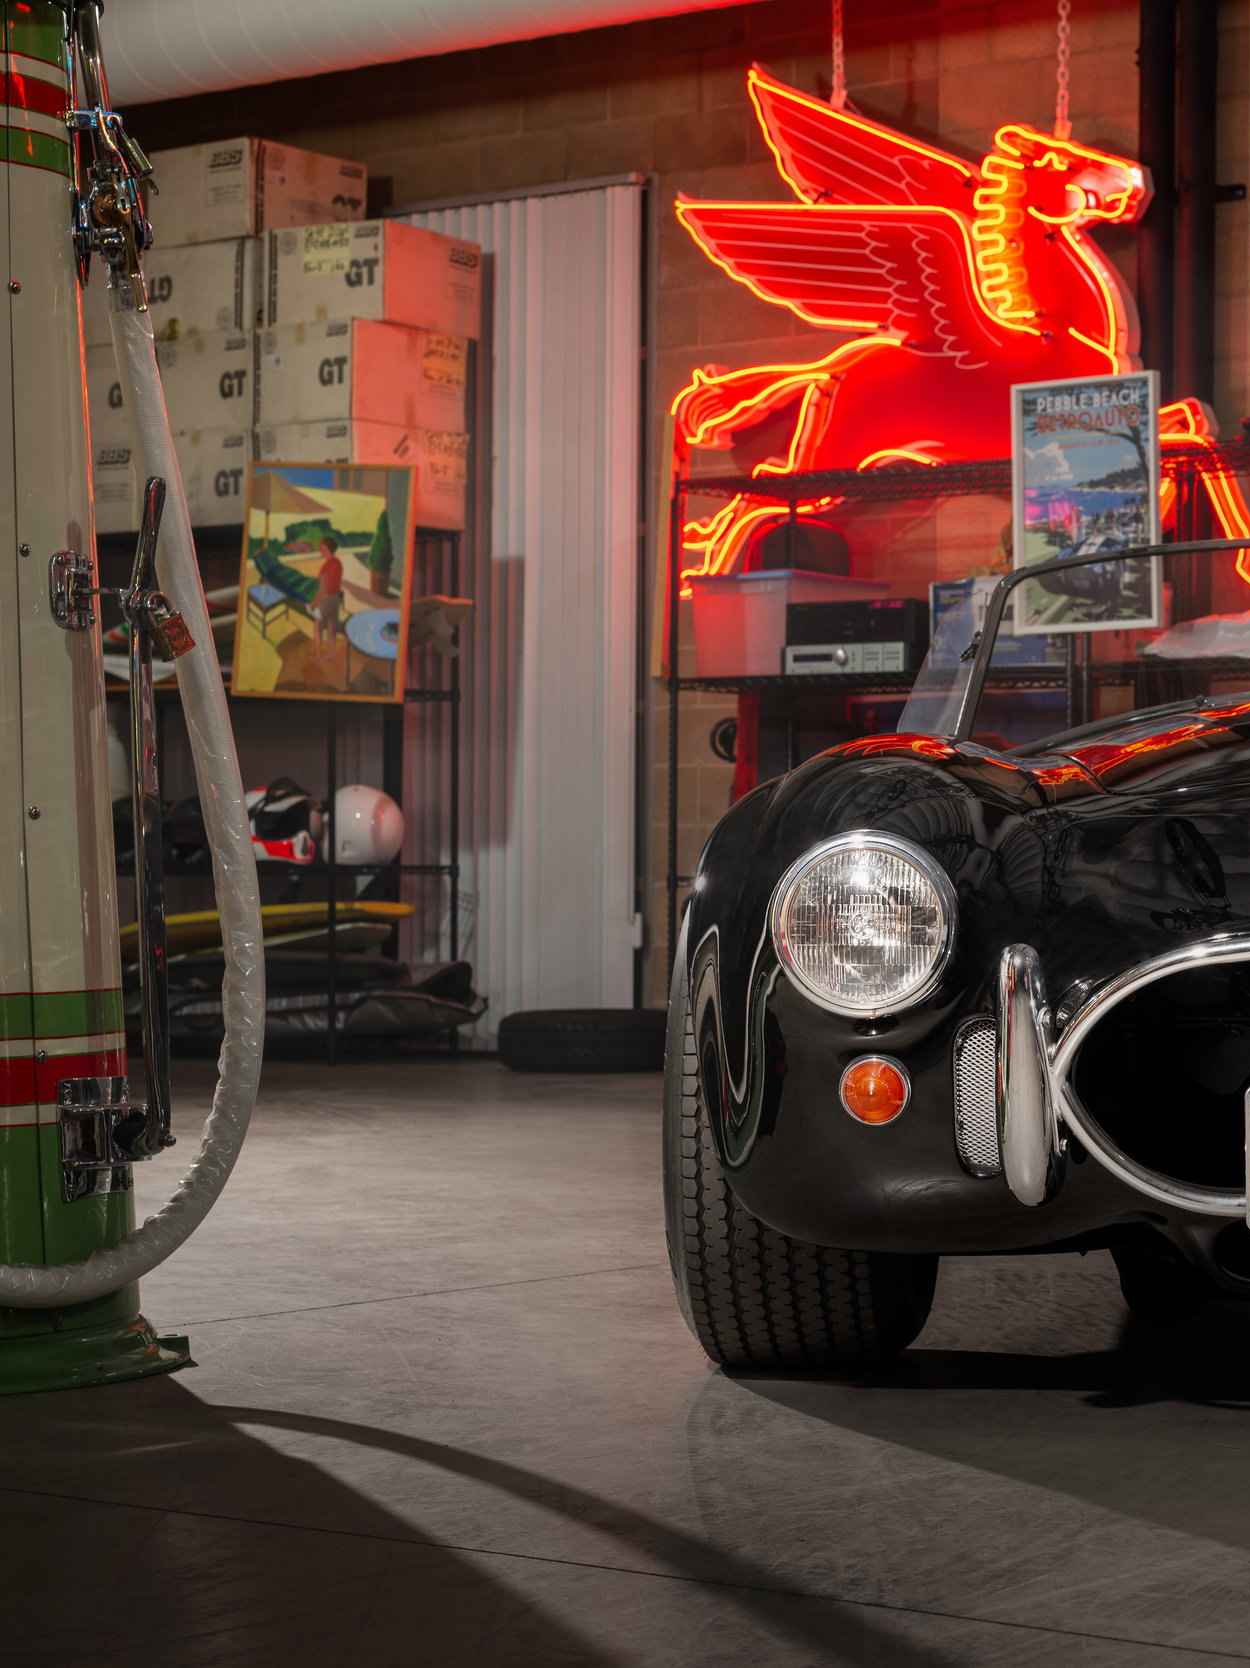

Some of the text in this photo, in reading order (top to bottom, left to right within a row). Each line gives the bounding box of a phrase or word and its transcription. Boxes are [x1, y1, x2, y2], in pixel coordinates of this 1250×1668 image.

[345, 257, 380, 288] GT
[219, 370, 247, 399] GT
[318, 356, 349, 387] GT
[1037, 388, 1140, 413] PEBBLE BEACH
[1036, 406, 1141, 434] RETROAUTO
[213, 467, 244, 498] GT
